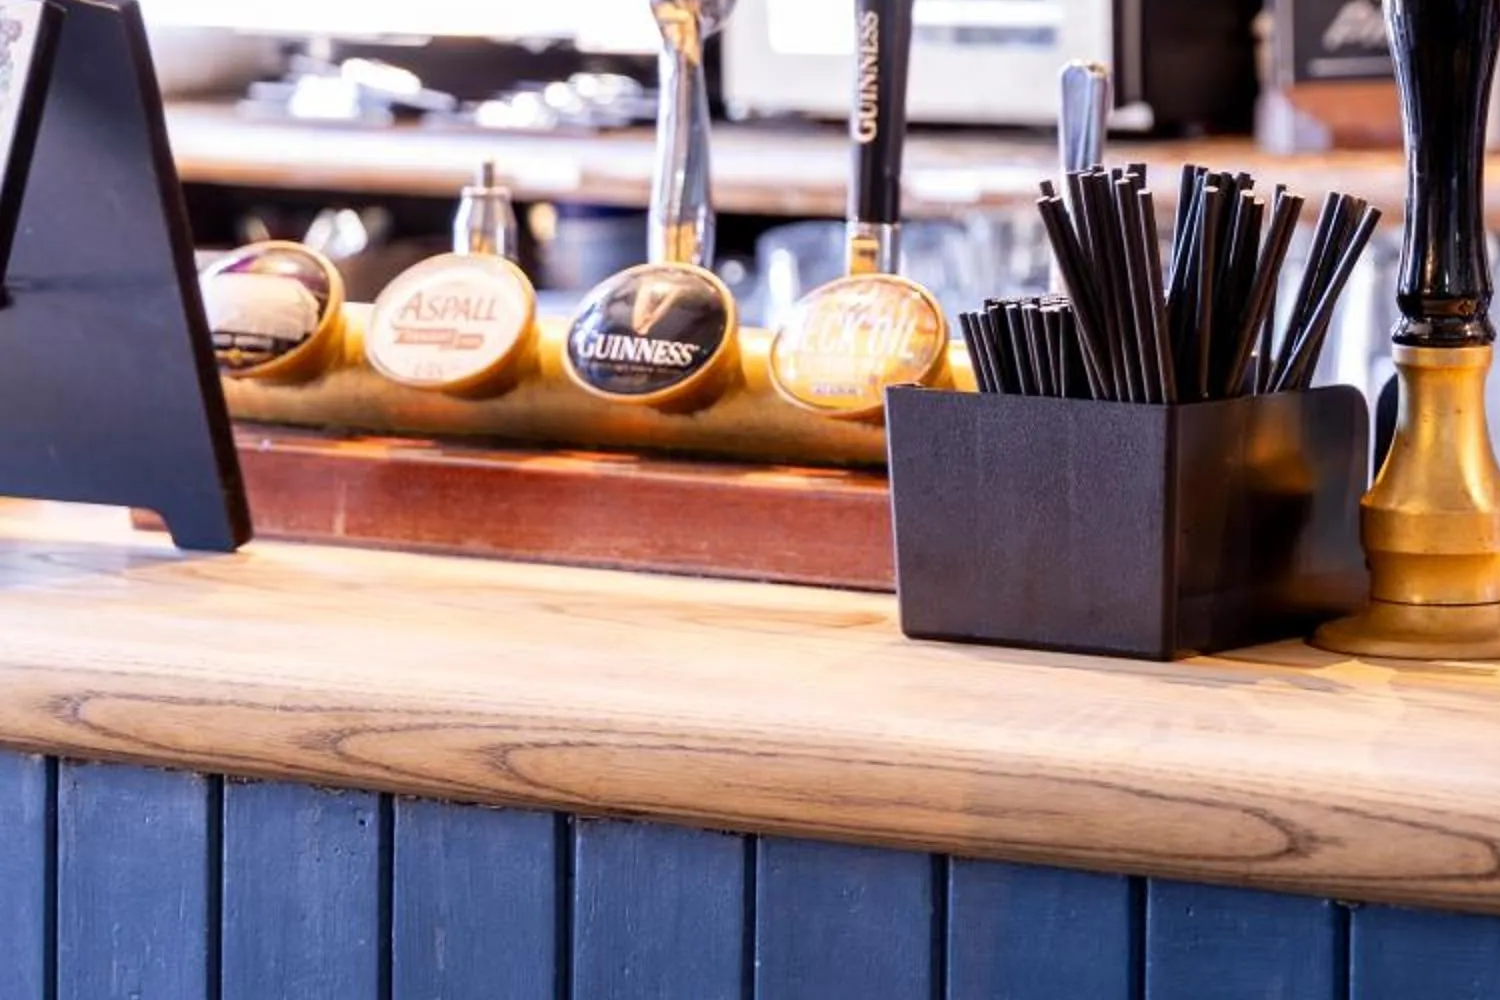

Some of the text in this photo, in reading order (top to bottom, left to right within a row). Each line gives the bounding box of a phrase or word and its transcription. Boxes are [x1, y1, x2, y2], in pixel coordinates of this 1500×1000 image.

[851, 10, 879, 143] GUINNESS
[401, 289, 496, 321] ASPALL
[574, 330, 693, 367] GUINNESS
